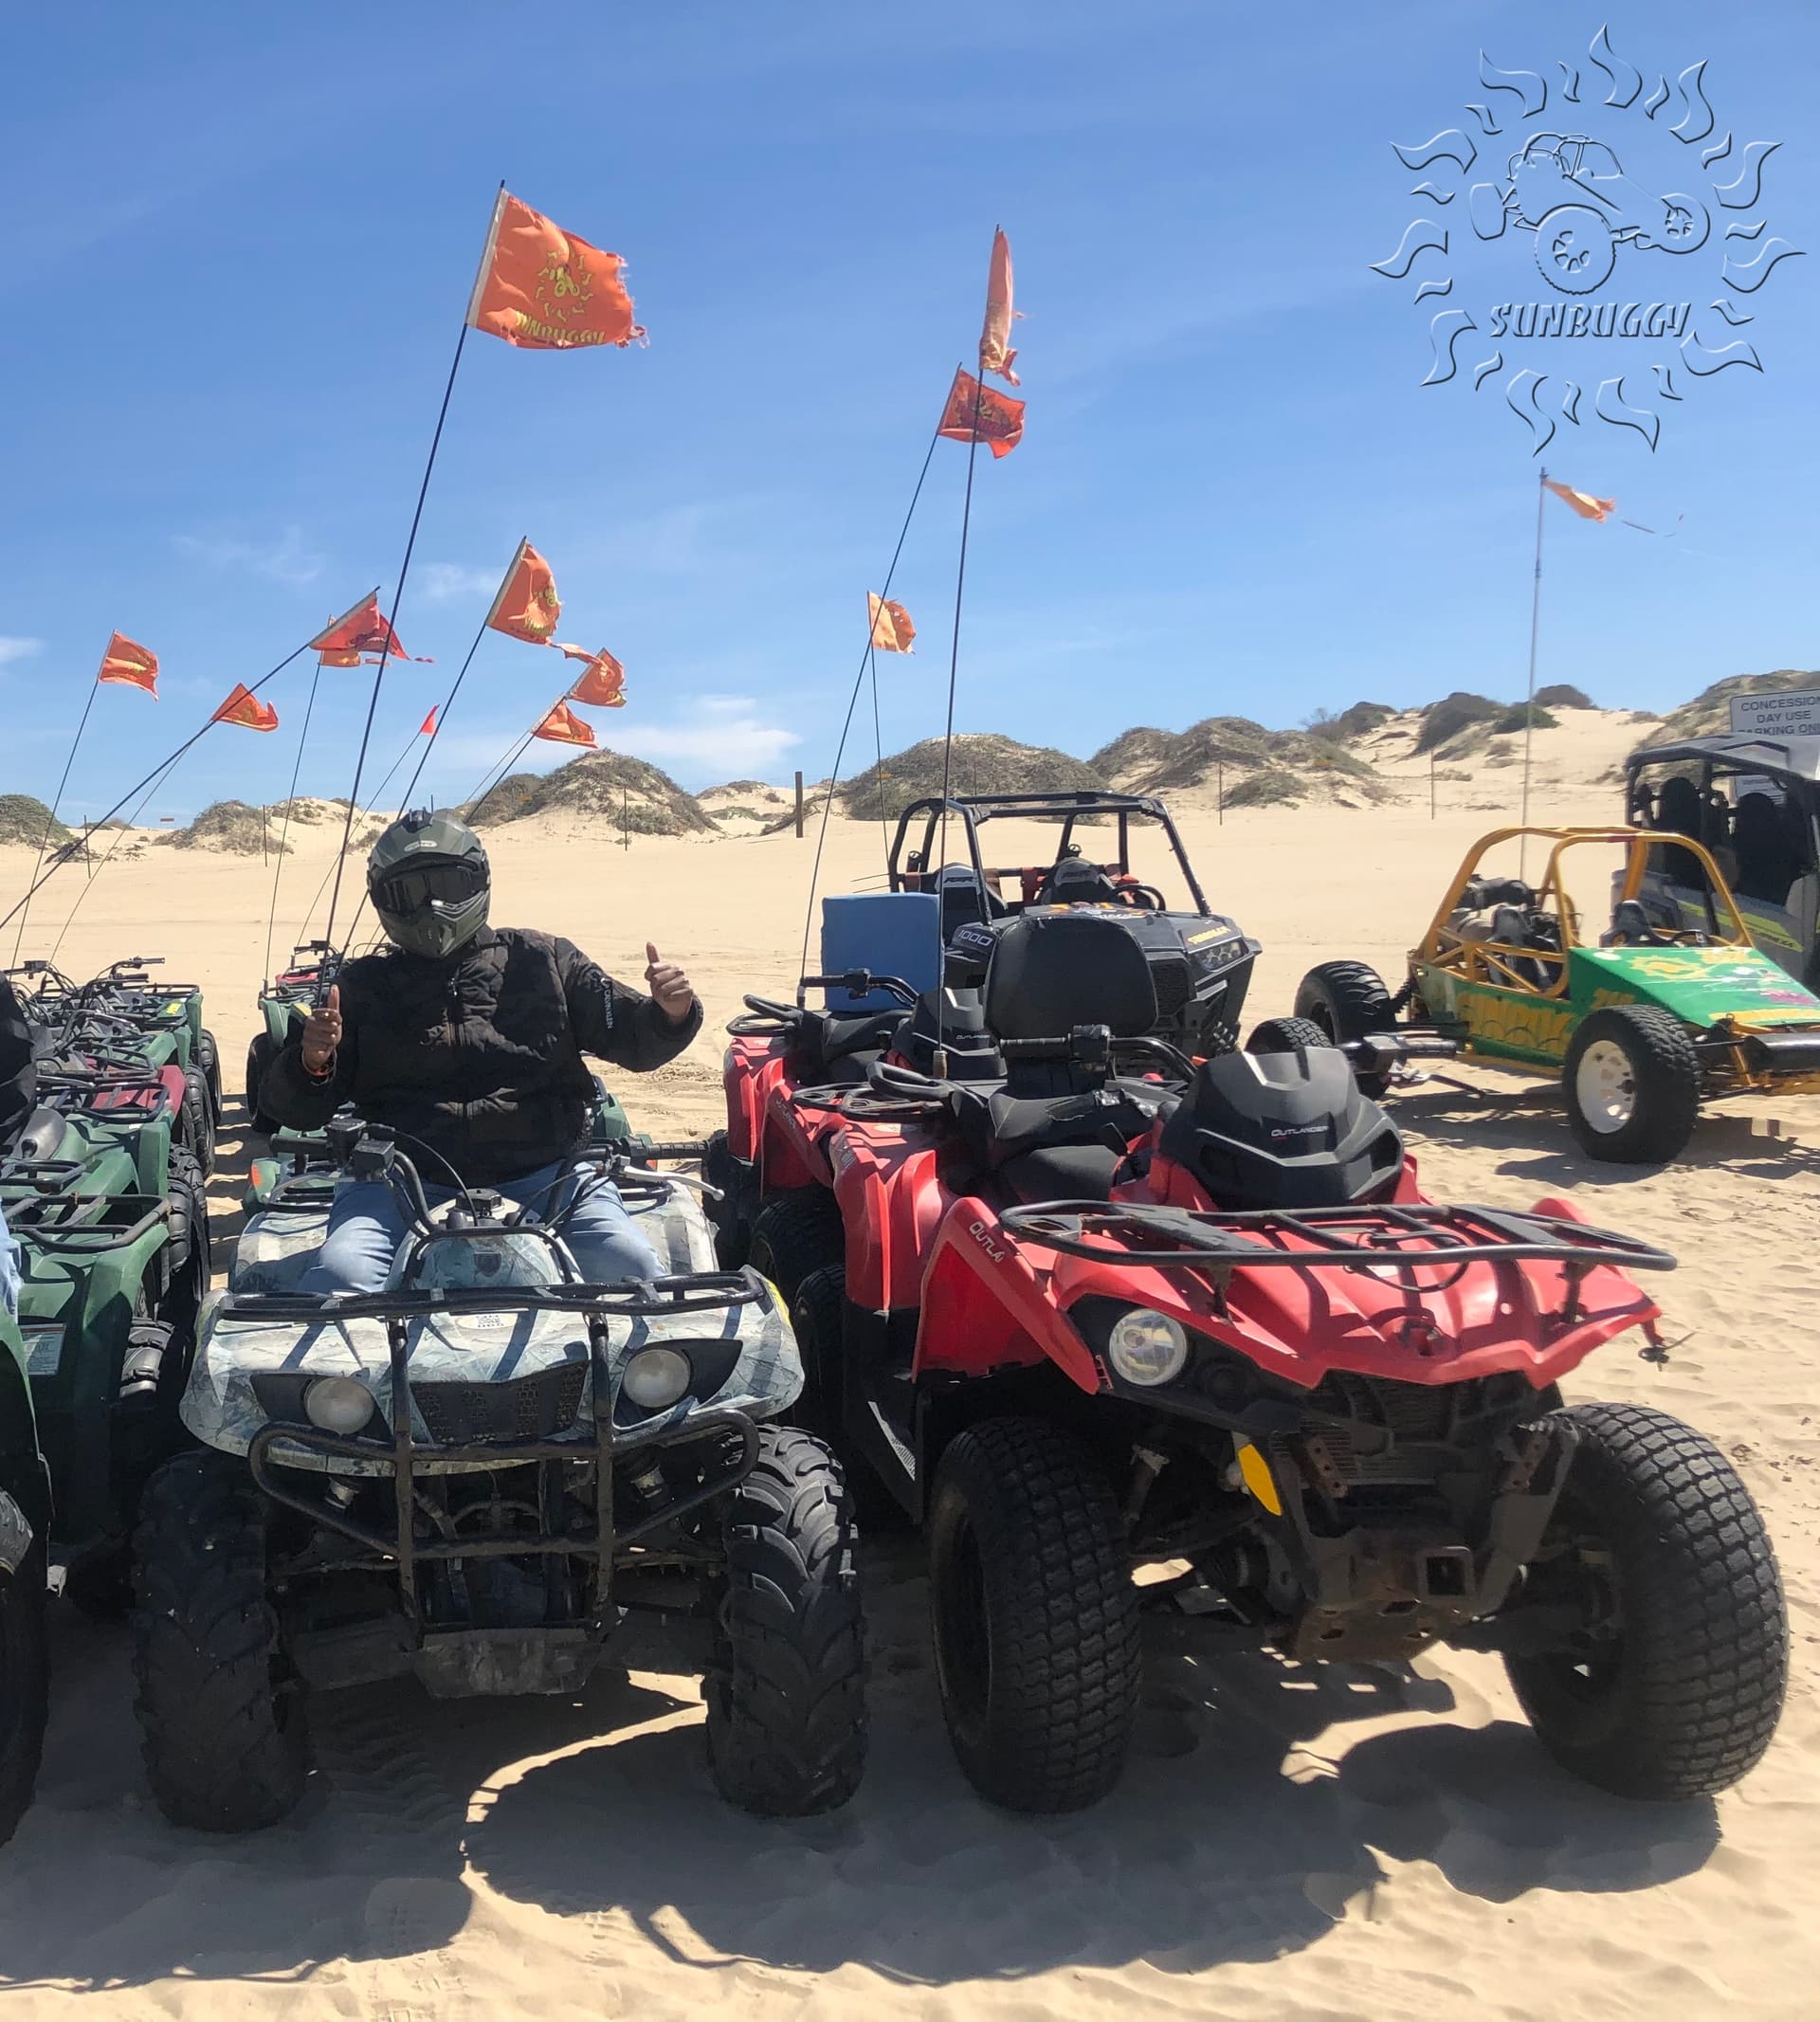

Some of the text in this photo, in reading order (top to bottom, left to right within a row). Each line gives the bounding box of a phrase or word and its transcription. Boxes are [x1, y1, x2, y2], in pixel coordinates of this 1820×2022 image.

[1756, 710, 1811, 723] DAY USE
[1737, 724, 1795, 737] RKING
[958, 929, 993, 946] 1000
[1271, 1125, 1329, 1137] OUTLANDER
